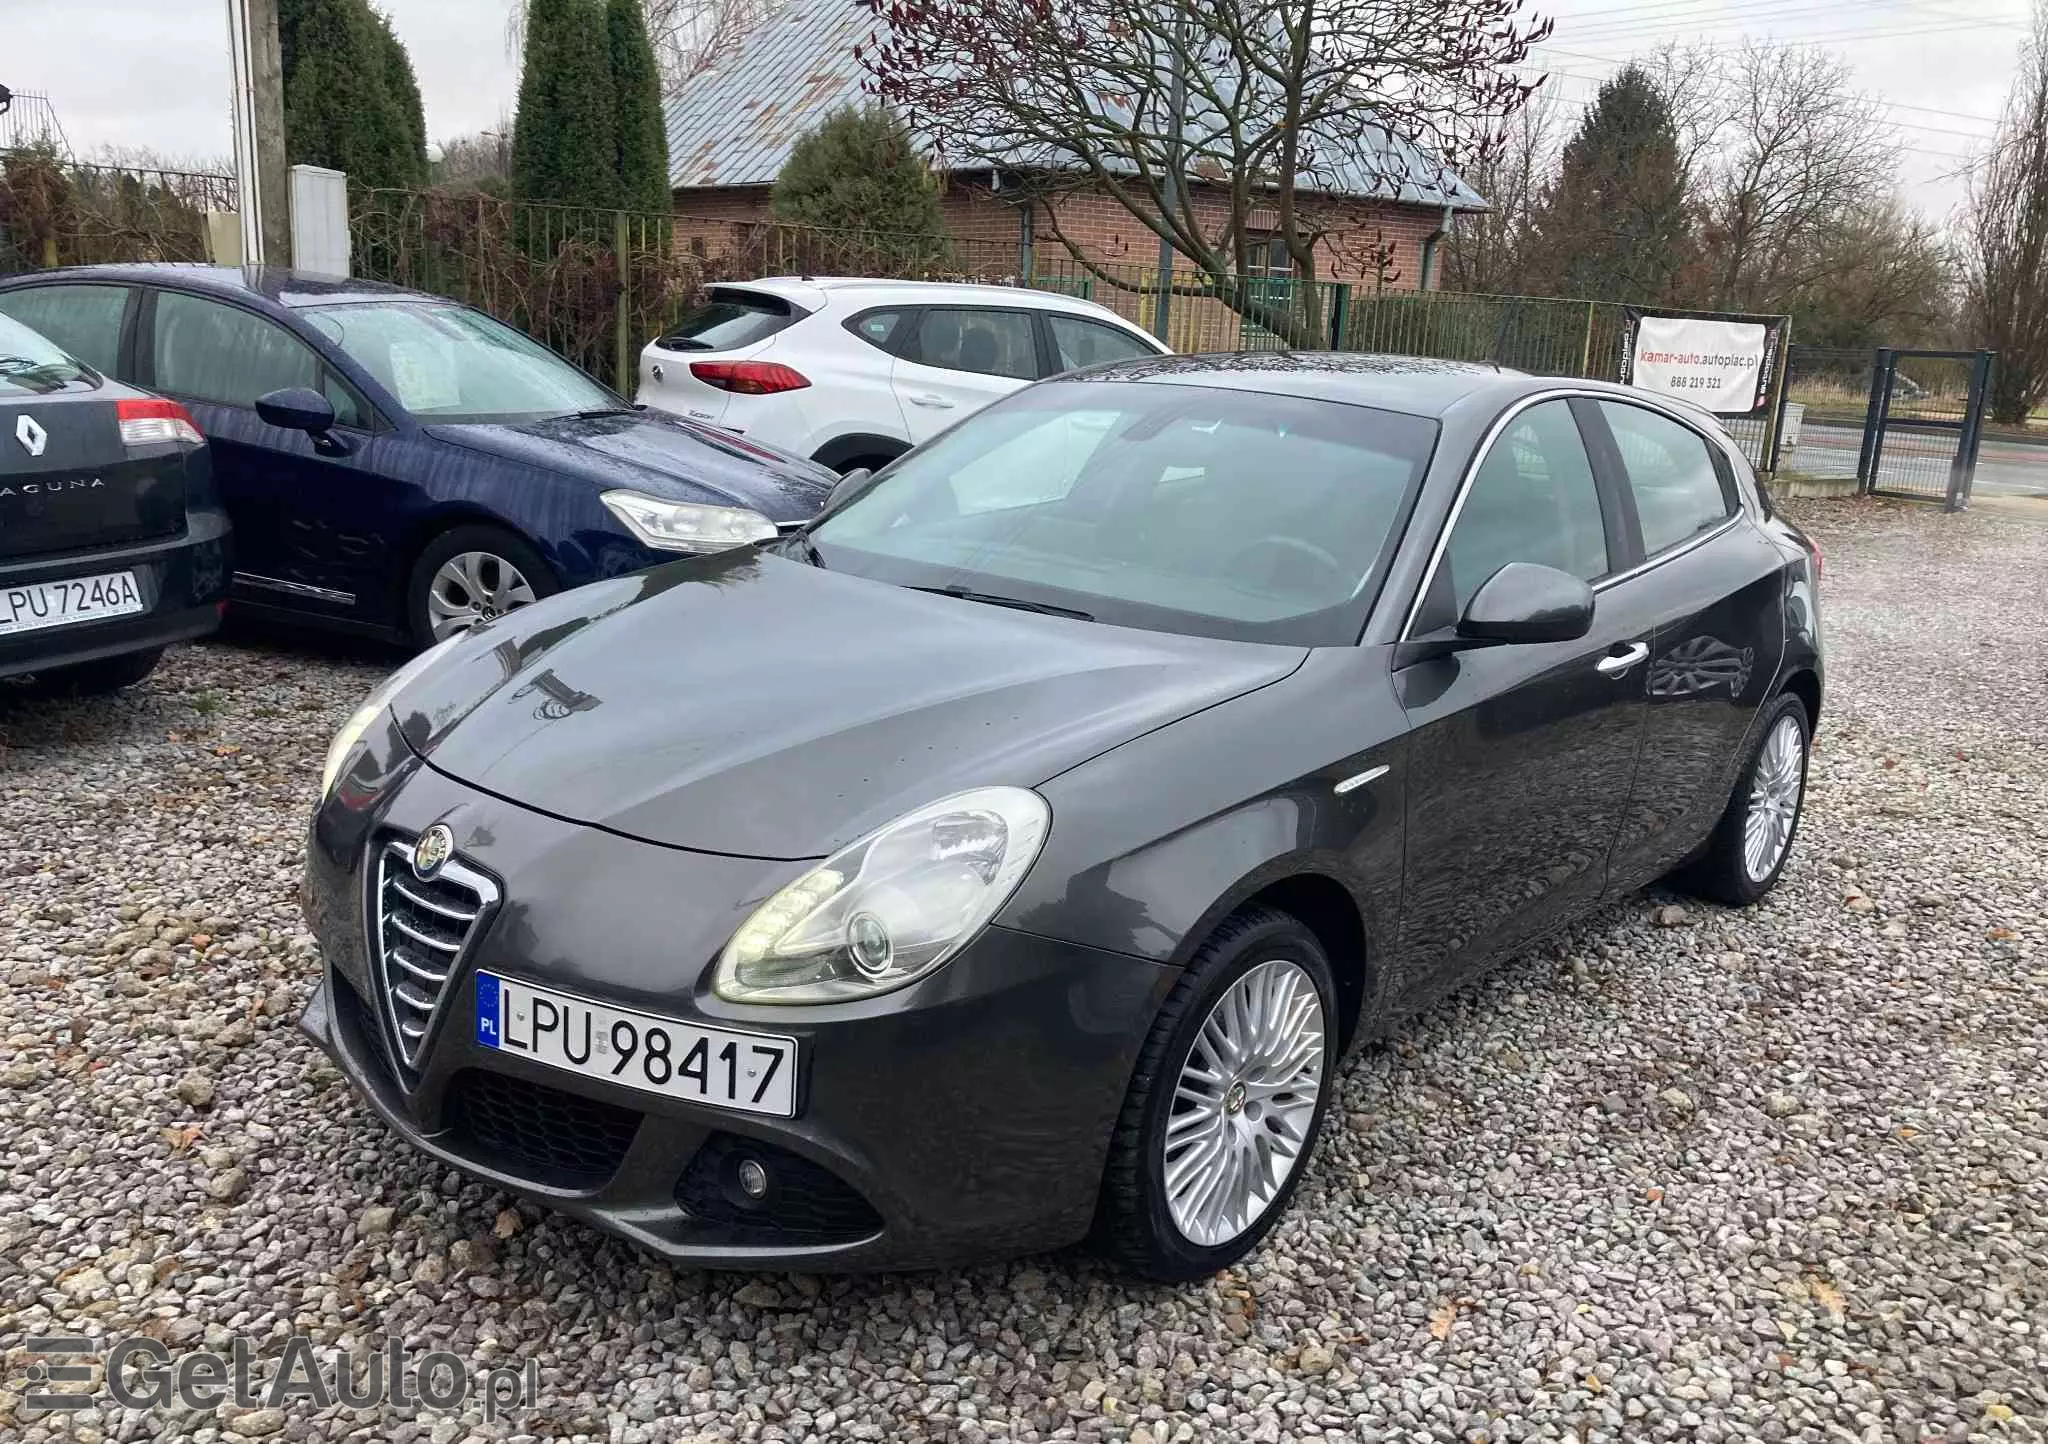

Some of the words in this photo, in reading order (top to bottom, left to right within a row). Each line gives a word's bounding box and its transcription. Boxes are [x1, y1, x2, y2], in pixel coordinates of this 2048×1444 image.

[1640, 348, 1758, 370] kamar-auto.autoplac.pl
[1670, 376, 1687, 388] 888
[1689, 377, 1704, 389] 219
[1706, 377, 1721, 389] 321
[0, 478, 104, 496] AGUNA
[54, 575, 137, 614] 7246A
[480, 1016, 497, 1036] PL
[504, 988, 592, 1065] LPU
[611, 1020, 785, 1103] 98417
